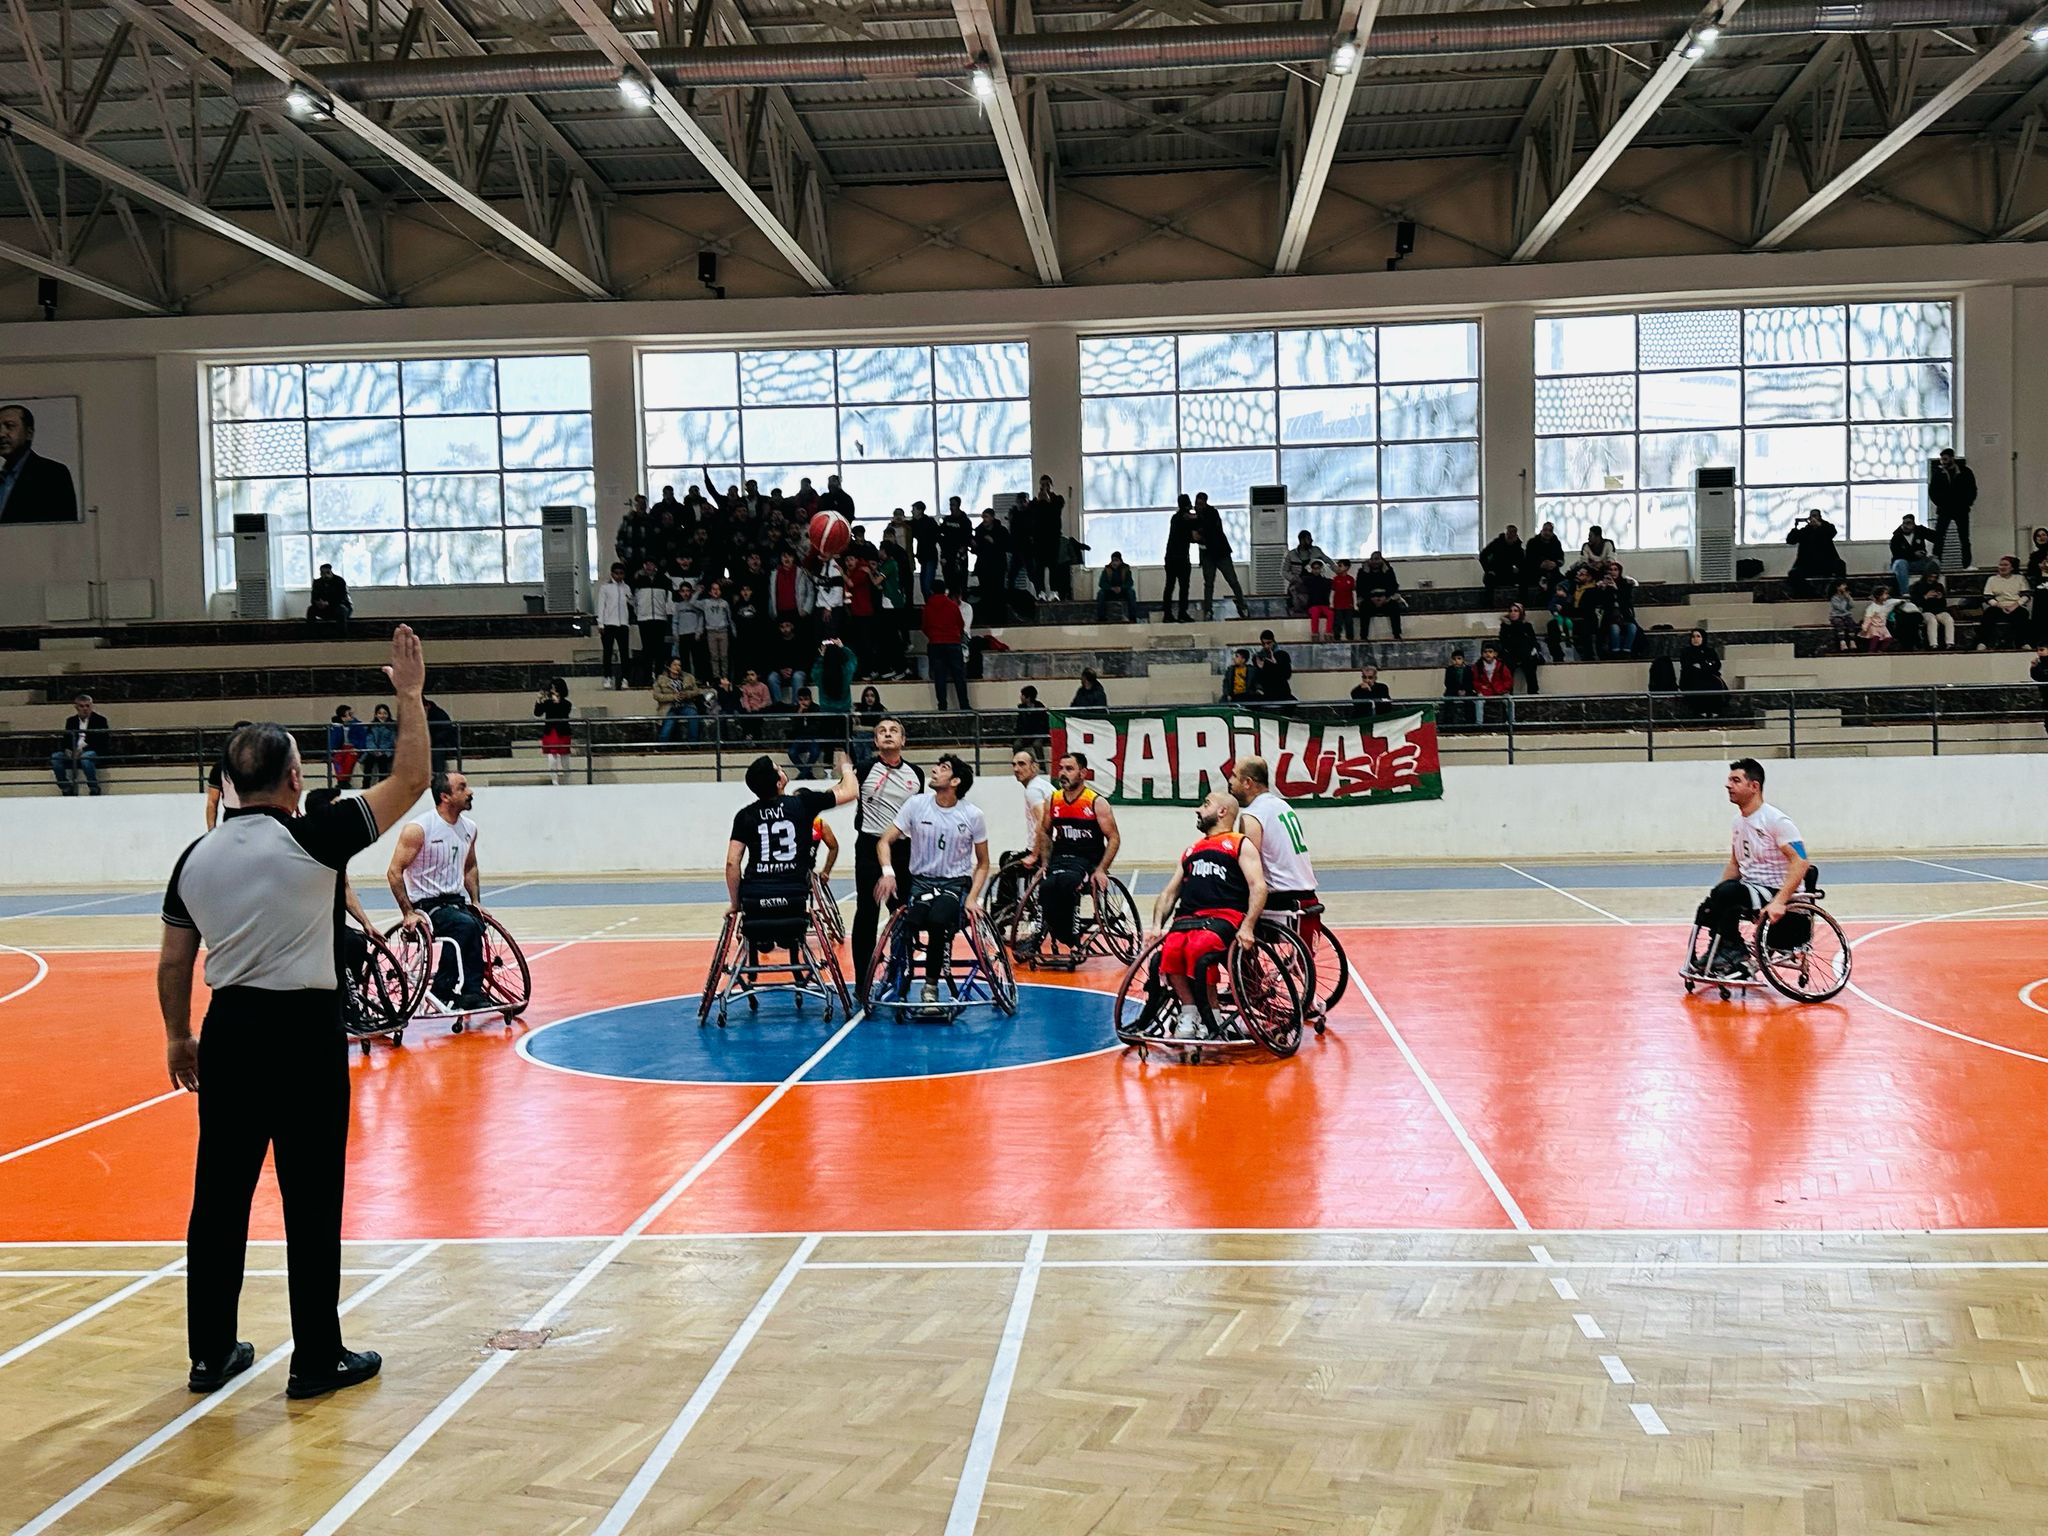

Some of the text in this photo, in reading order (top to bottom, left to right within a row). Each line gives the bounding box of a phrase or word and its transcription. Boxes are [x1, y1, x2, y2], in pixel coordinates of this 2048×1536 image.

[1053, 806, 1061, 818] 5
[757, 819, 798, 862] 13
[938, 833, 946, 851] 6
[1743, 840, 1750, 859] 5
[452, 845, 459, 864] 7
